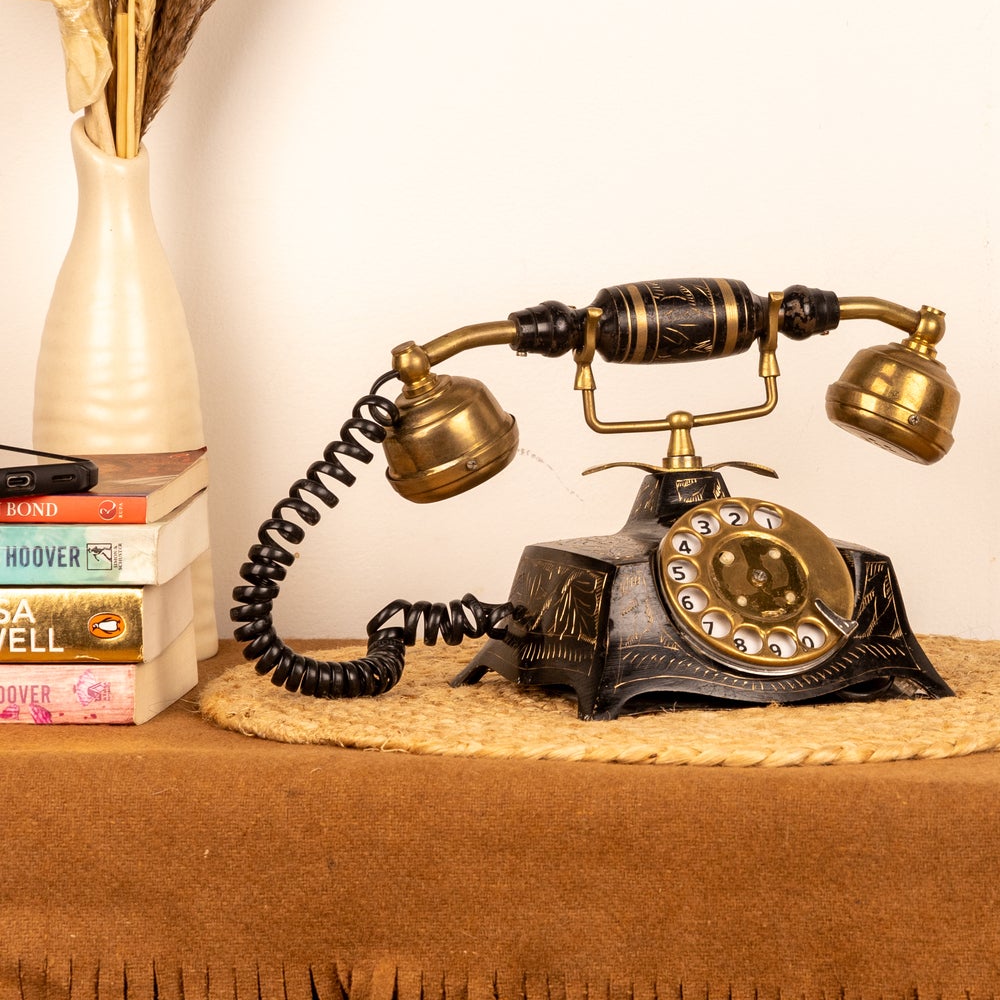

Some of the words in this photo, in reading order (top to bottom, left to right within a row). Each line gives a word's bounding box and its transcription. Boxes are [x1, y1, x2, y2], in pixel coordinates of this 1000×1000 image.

[6, 502, 58, 516] BOND
[728, 512, 743, 527] 2
[697, 520, 712, 535] 3
[678, 540, 692, 554] 4
[6, 545, 81, 567] HOOVER
[672, 566, 686, 580] 5
[681, 595, 694, 610] 6
[702, 621, 714, 636] 7
[0, 627, 64, 653] ELL
[734, 638, 747, 653] 8
[770, 643, 782, 657] 9
